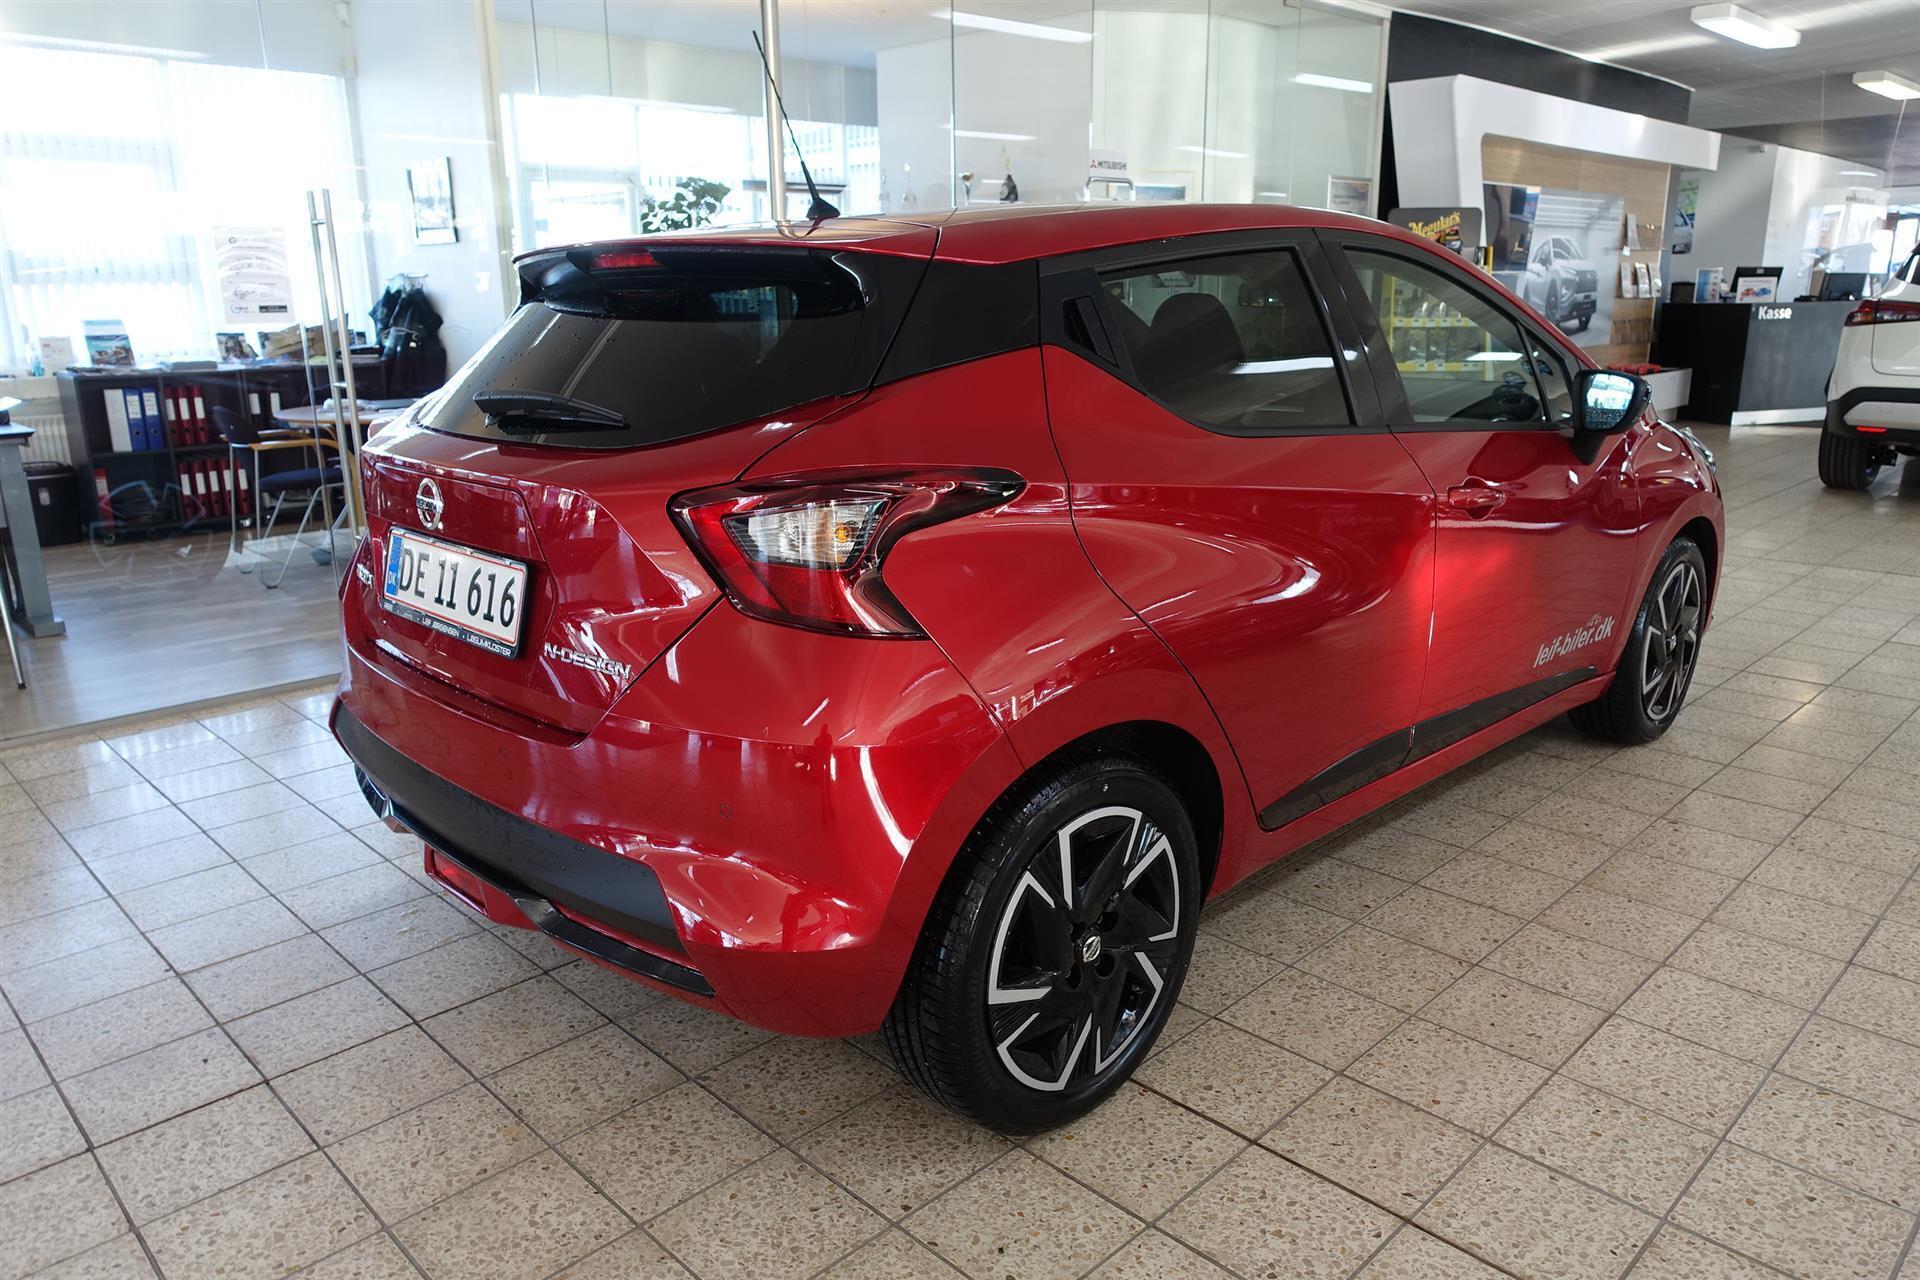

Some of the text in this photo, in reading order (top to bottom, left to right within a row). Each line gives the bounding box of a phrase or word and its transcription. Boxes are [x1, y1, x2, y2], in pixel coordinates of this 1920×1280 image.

[1758, 306, 1792, 320] Kasse
[387, 571, 397, 586] DK
[399, 548, 430, 599] DE
[434, 559, 458, 610] 11
[467, 566, 516, 628] 616
[543, 642, 631, 680] N-DESIGN
[1532, 615, 1615, 669] leif-biler.dk
